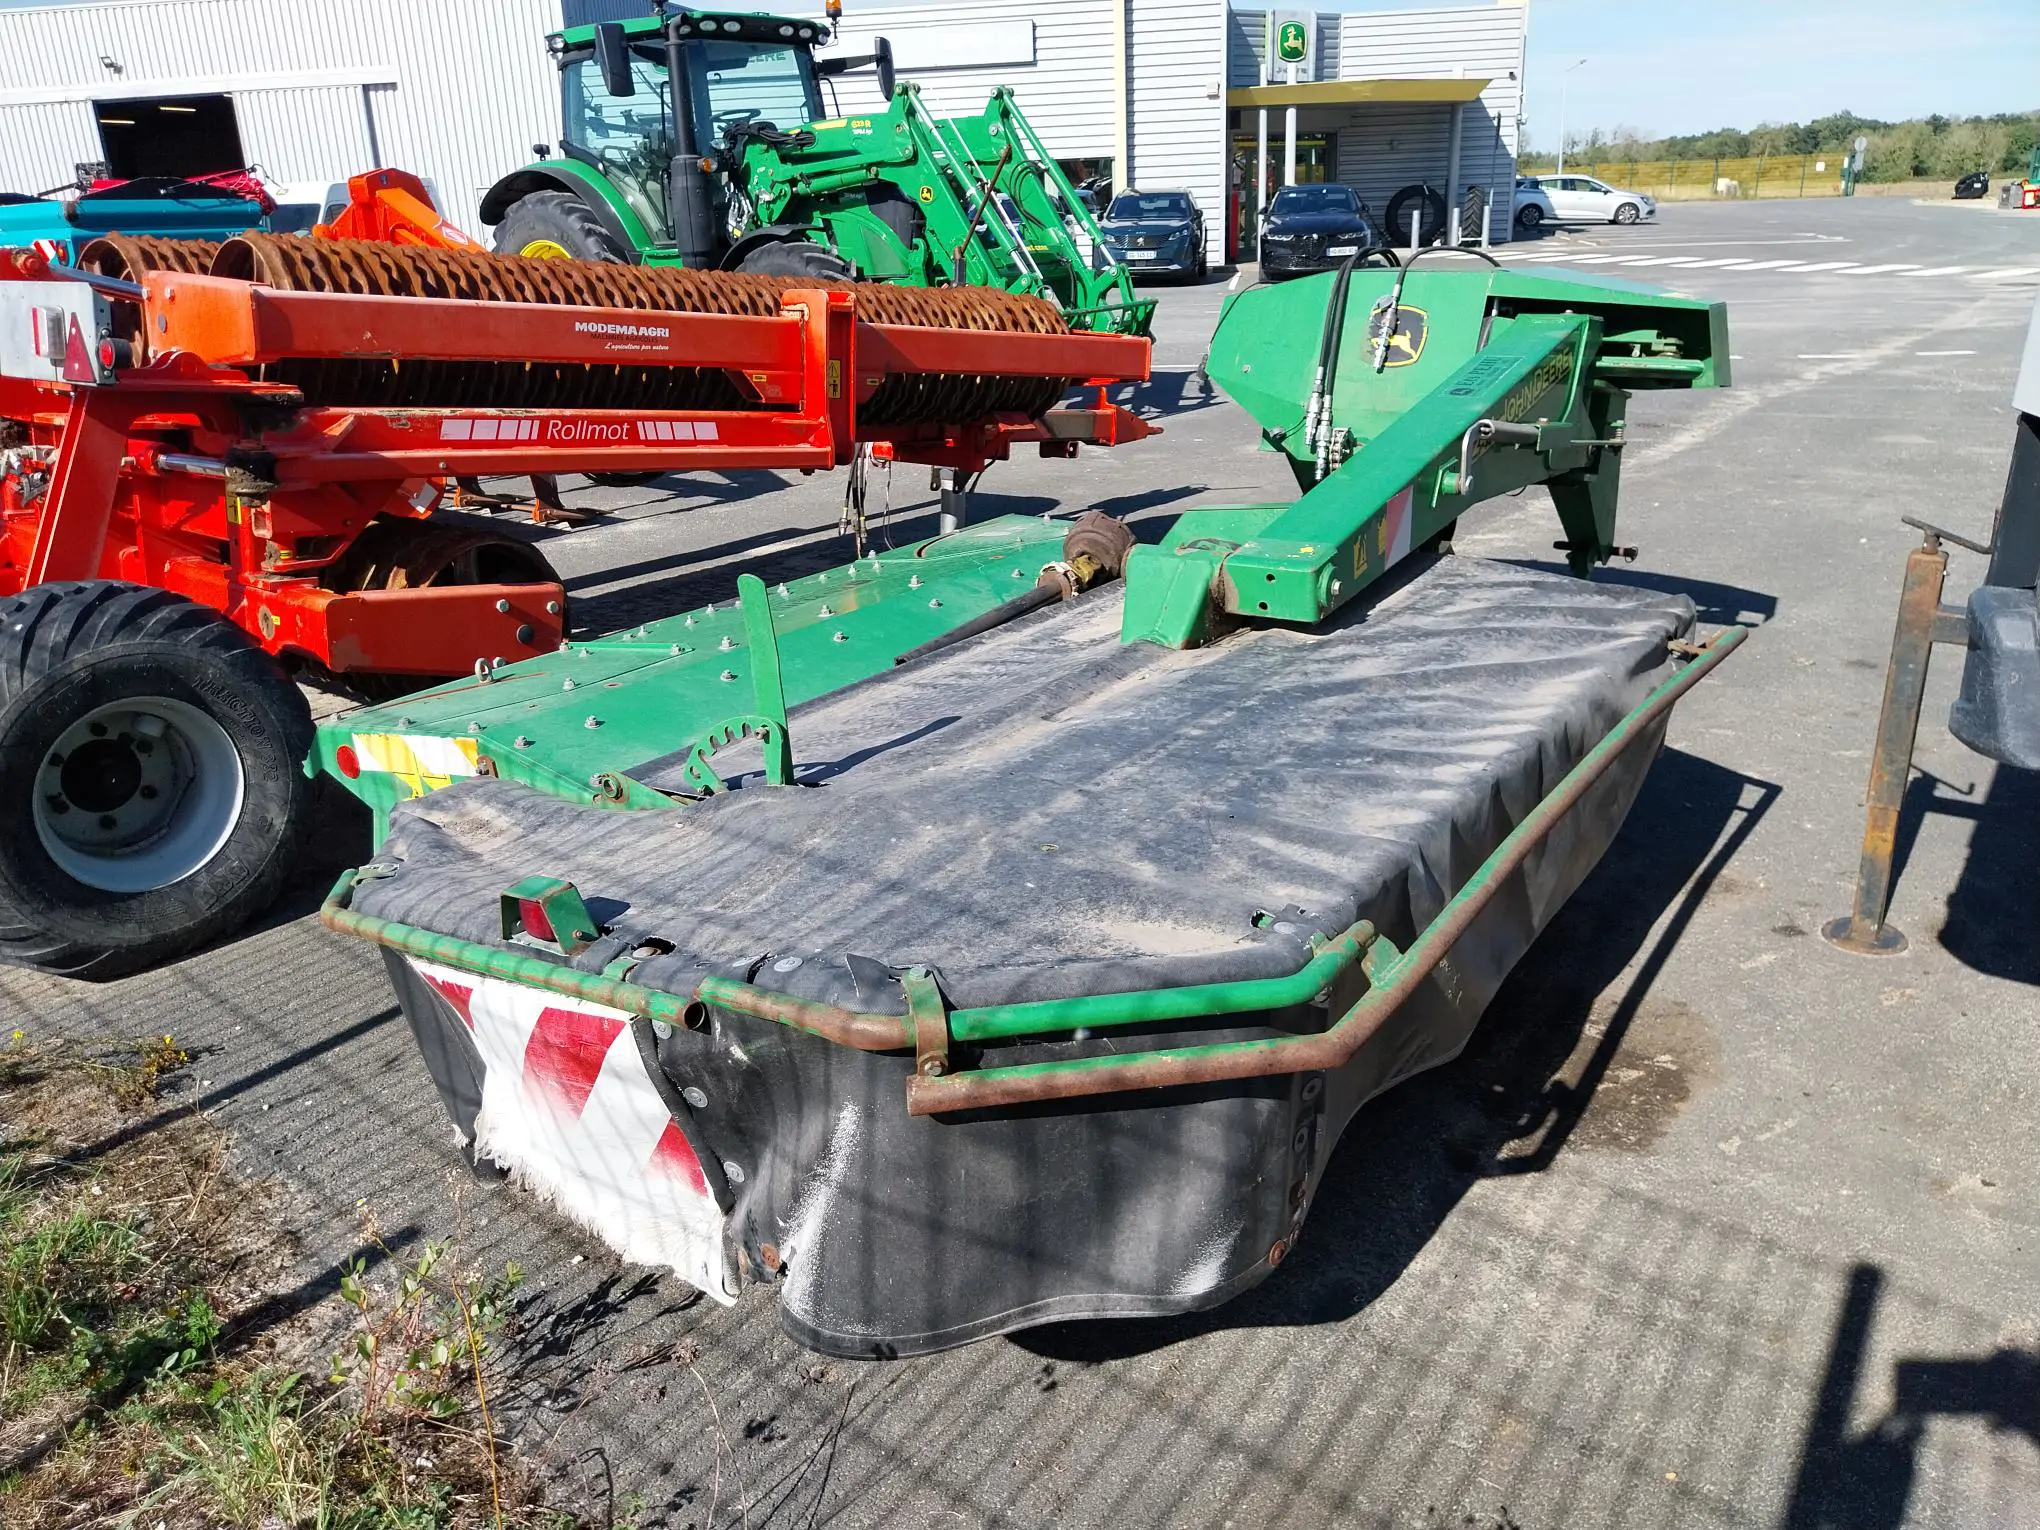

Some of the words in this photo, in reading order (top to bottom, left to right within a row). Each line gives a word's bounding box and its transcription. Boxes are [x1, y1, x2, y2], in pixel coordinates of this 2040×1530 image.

[1504, 381, 1533, 422] JOHN
[1534, 348, 1570, 395] DEERE
[546, 420, 630, 440] Rollmot
